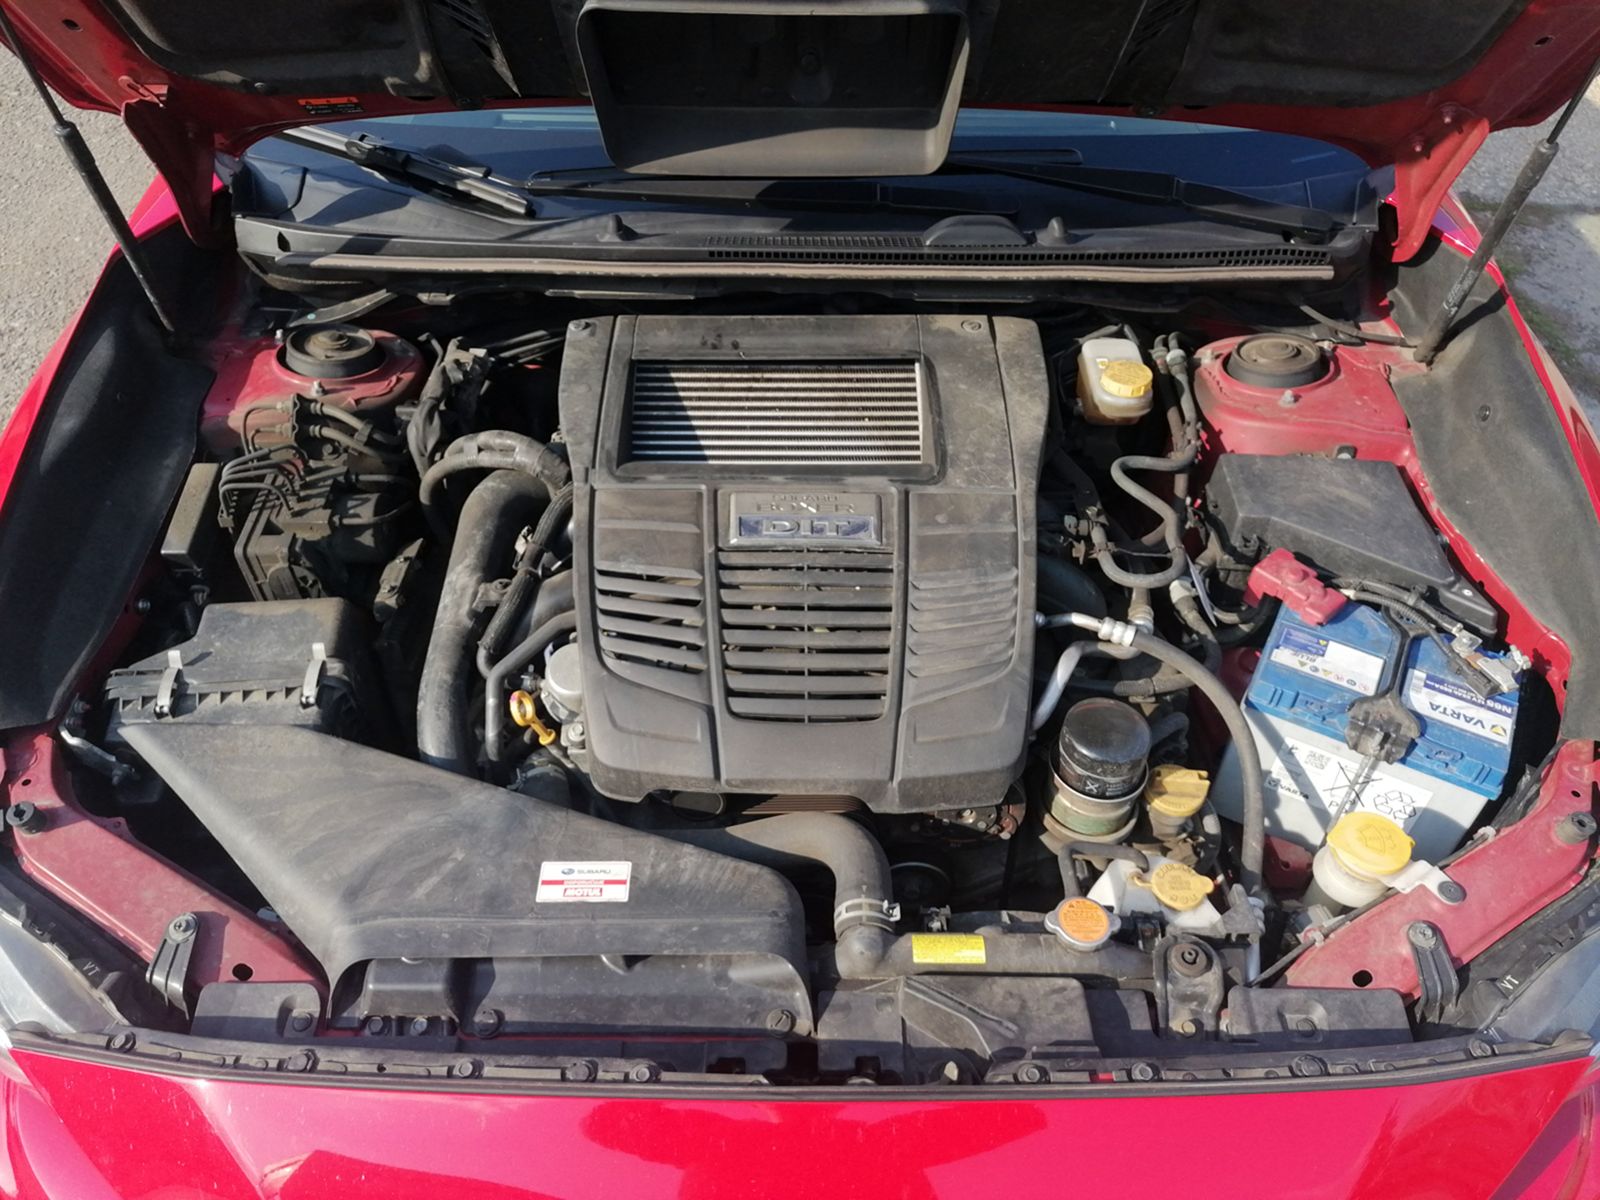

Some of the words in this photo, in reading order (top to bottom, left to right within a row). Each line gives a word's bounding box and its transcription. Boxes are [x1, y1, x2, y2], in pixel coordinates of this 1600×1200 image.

[757, 502, 856, 513] BOXER
[763, 519, 851, 536] DIT
[1486, 699, 1513, 714] N65
[1428, 701, 1486, 730] VARTA
[564, 887, 601, 897] MOTUL
[82, 961, 101, 976] VT
[1500, 974, 1520, 990] VT
